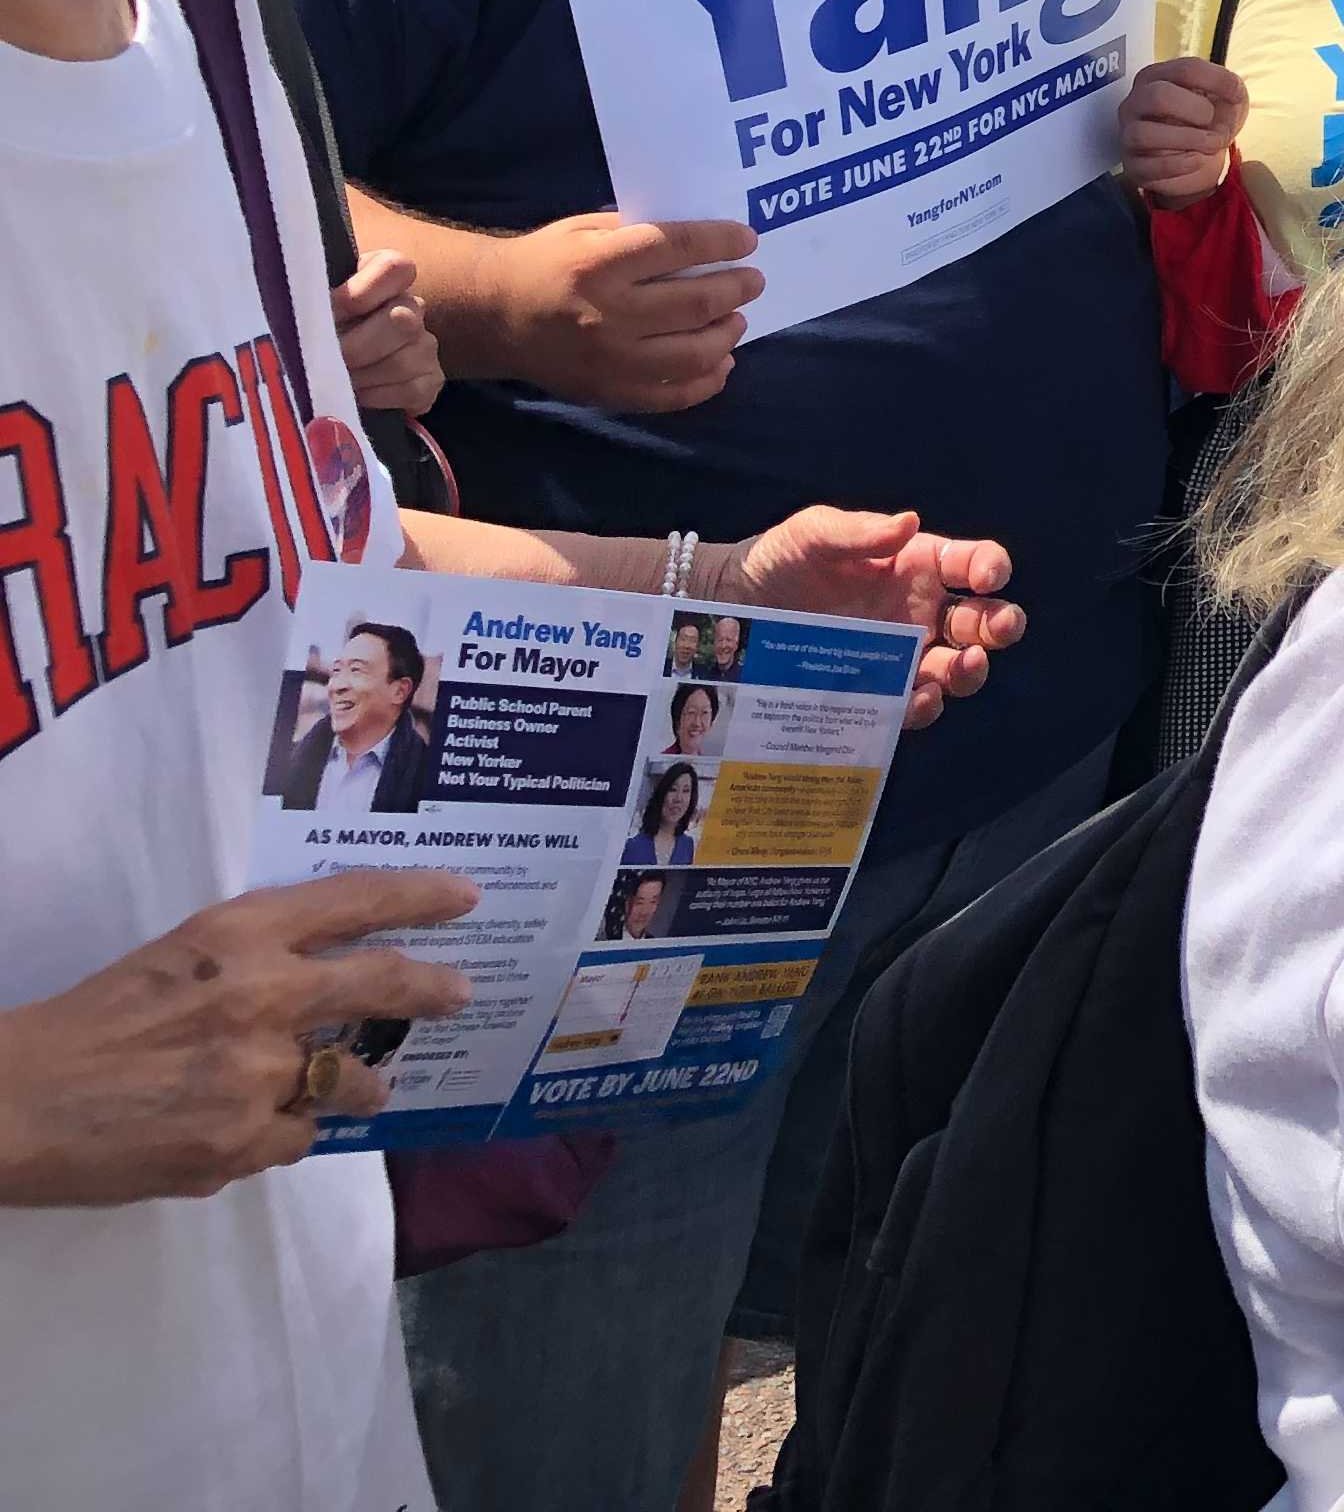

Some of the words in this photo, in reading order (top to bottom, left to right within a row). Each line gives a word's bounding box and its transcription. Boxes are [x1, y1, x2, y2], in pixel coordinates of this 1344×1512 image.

[734, 106, 825, 169] For
[837, 68, 941, 136] New
[948, 23, 1032, 88] York
[758, 178, 833, 220] VOTE
[841, 151, 908, 195] JUNE
[913, 124, 963, 164] 22ND
[967, 107, 1006, 144] FOR
[1010, 83, 1050, 120] NYC
[1054, 51, 1121, 103] MAYOR
[906, 172, 1003, 229] YangforNY.com
[463, 610, 575, 645] Andrew
[582, 621, 644, 658] Yang
[458, 642, 506, 671] For
[512, 647, 600, 682] Mayor
[450, 695, 496, 713] Public
[499, 698, 548, 716] School
[549, 702, 593, 719] Parent
[447, 715, 512, 733] Business
[514, 718, 560, 735] Owner
[444, 733, 500, 750] Activist
[441, 751, 475, 768] New
[477, 753, 523, 769] Yorker
[438, 771, 465, 786] Not
[468, 772, 501, 787] Your
[503, 773, 550, 791] Typical
[552, 775, 611, 791] Politician
[305, 829, 332, 846] AS
[336, 830, 410, 848] MAYOR,
[415, 831, 497, 848] ANDREW
[498, 833, 541, 849] YANG
[545, 834, 580, 849] WILL
[529, 1075, 598, 1105] VOTE
[599, 1072, 630, 1099] BY
[632, 1065, 694, 1093] JUNE
[698, 1059, 761, 1087] 22ND
